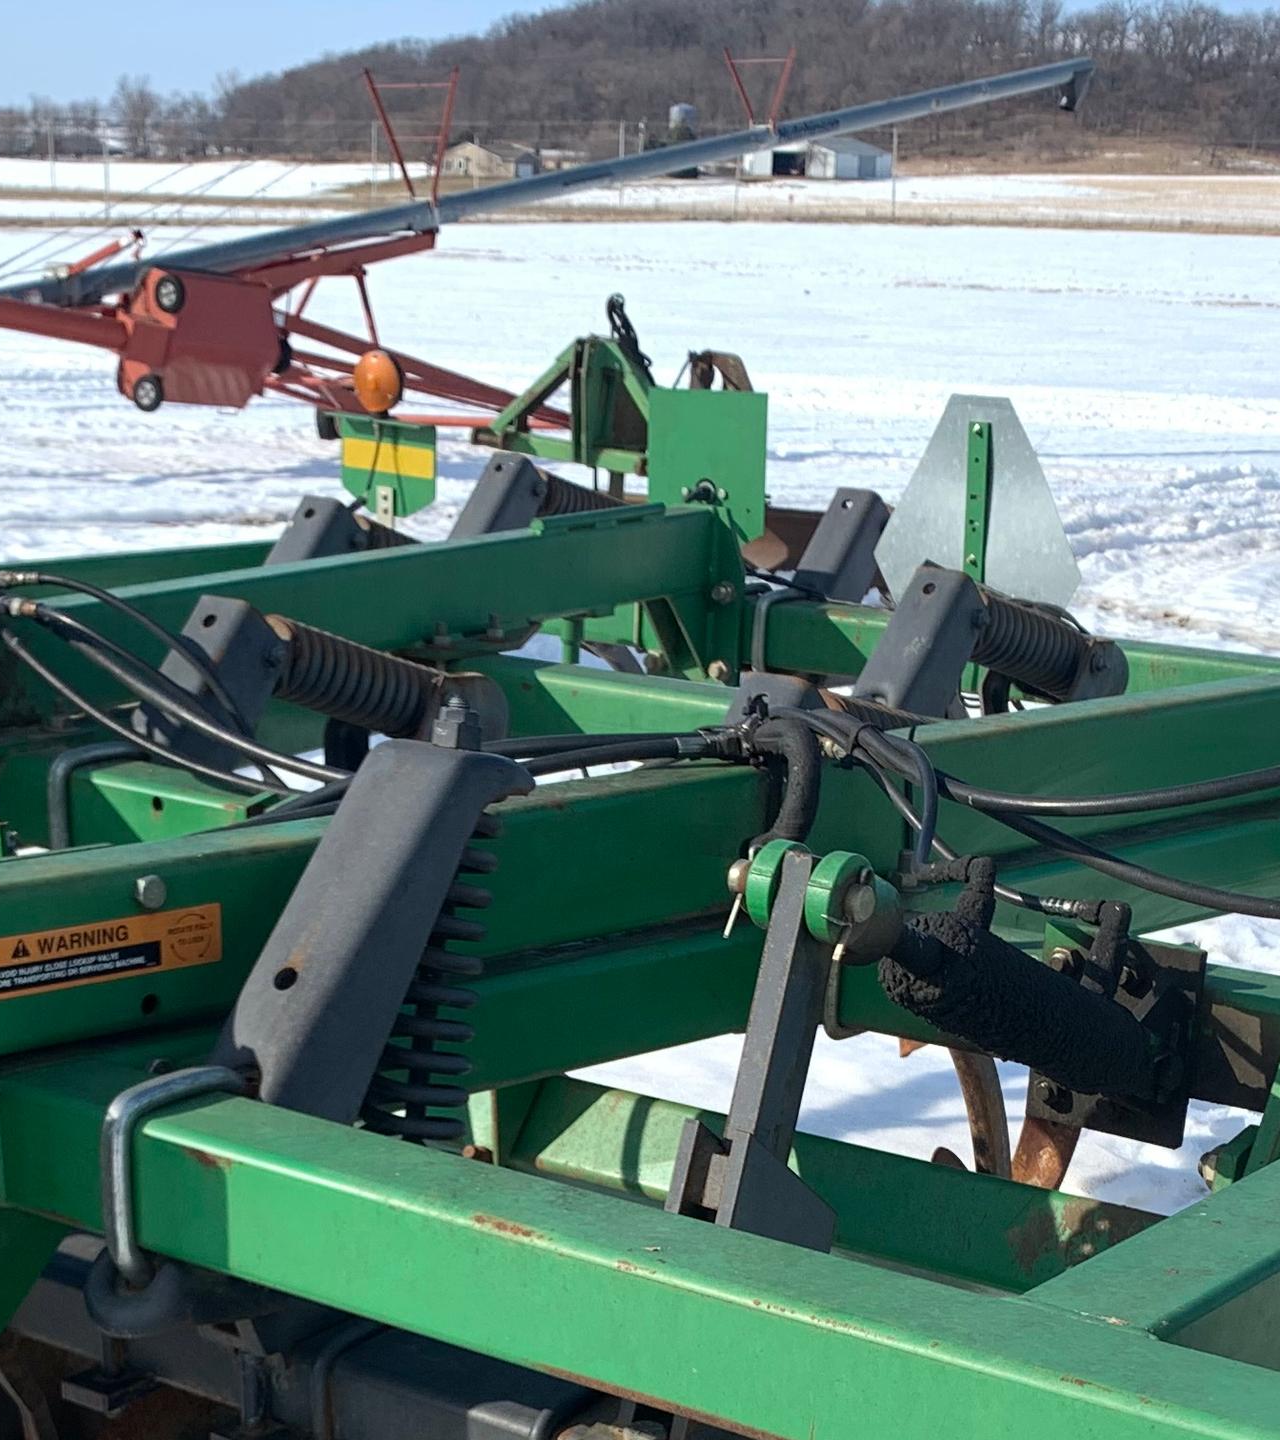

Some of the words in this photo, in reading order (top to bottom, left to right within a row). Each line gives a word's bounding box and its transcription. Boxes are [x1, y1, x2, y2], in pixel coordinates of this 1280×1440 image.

[37, 925, 129, 955] WARNING
[13, 970, 67, 985] TRANSPORTING
[67, 968, 79, 977] OR
[79, 961, 115, 975] SERVICING
[18, 964, 44, 976] INJURY
[97, 951, 120, 963] VALVE
